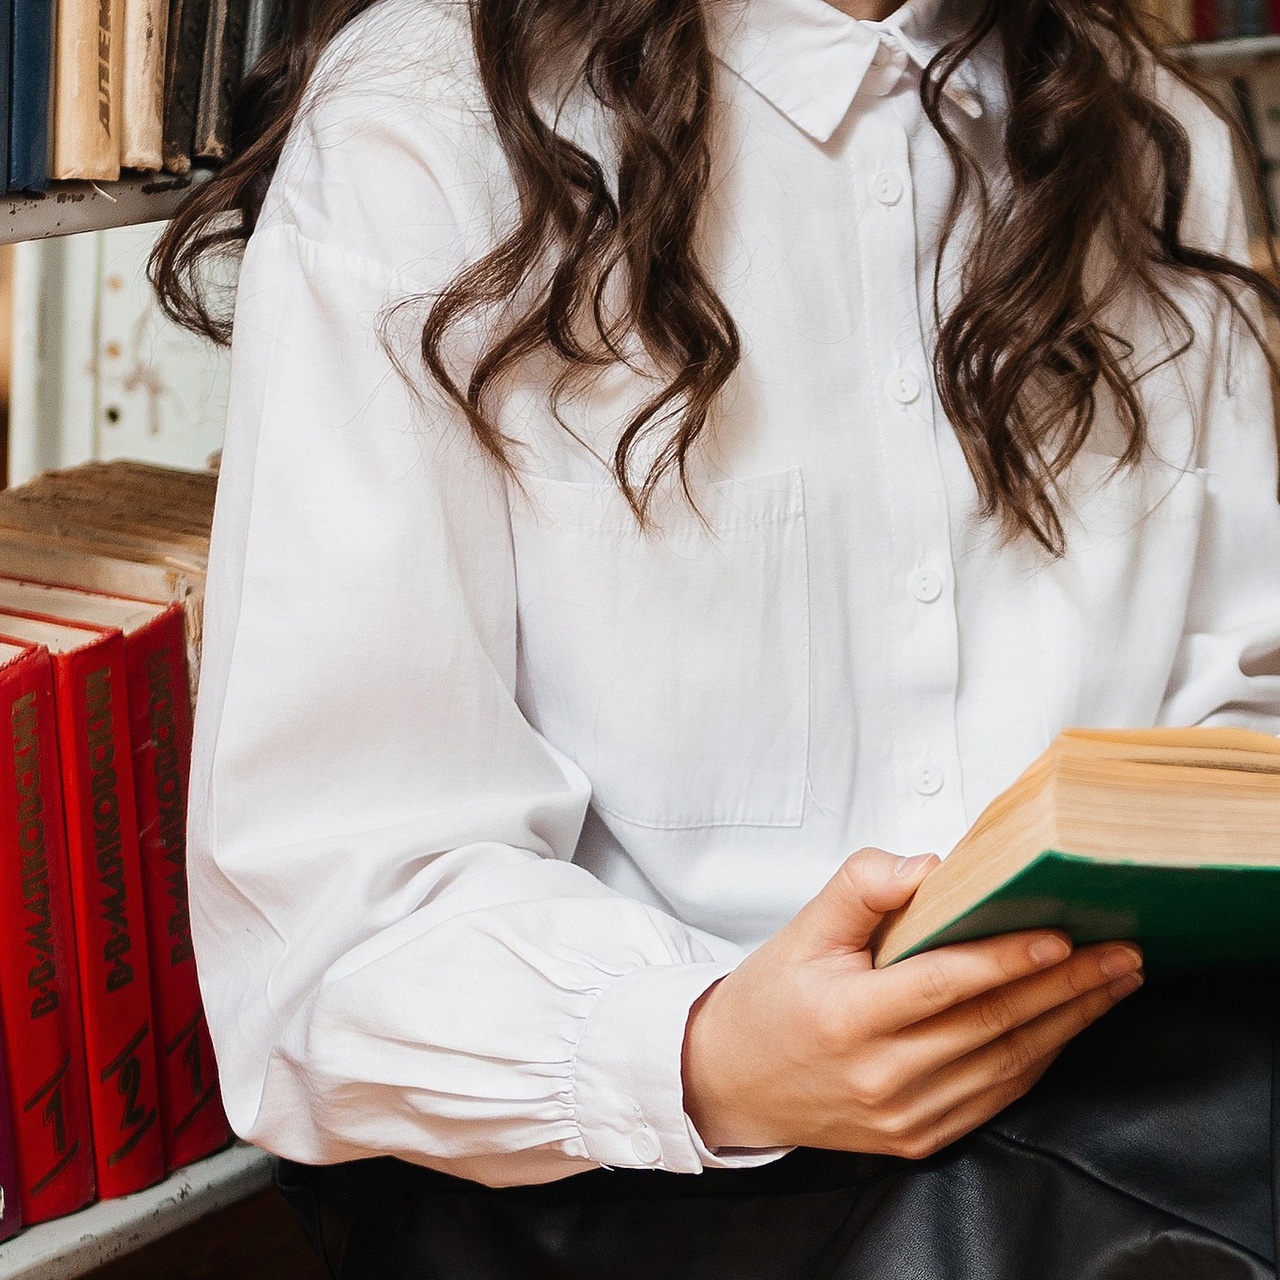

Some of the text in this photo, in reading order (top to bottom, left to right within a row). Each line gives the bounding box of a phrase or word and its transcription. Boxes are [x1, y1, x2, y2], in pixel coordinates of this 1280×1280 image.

[117, 1055, 146, 1131] 2
[183, 1023, 203, 1096] 1
[43, 1084, 66, 1155] 1
